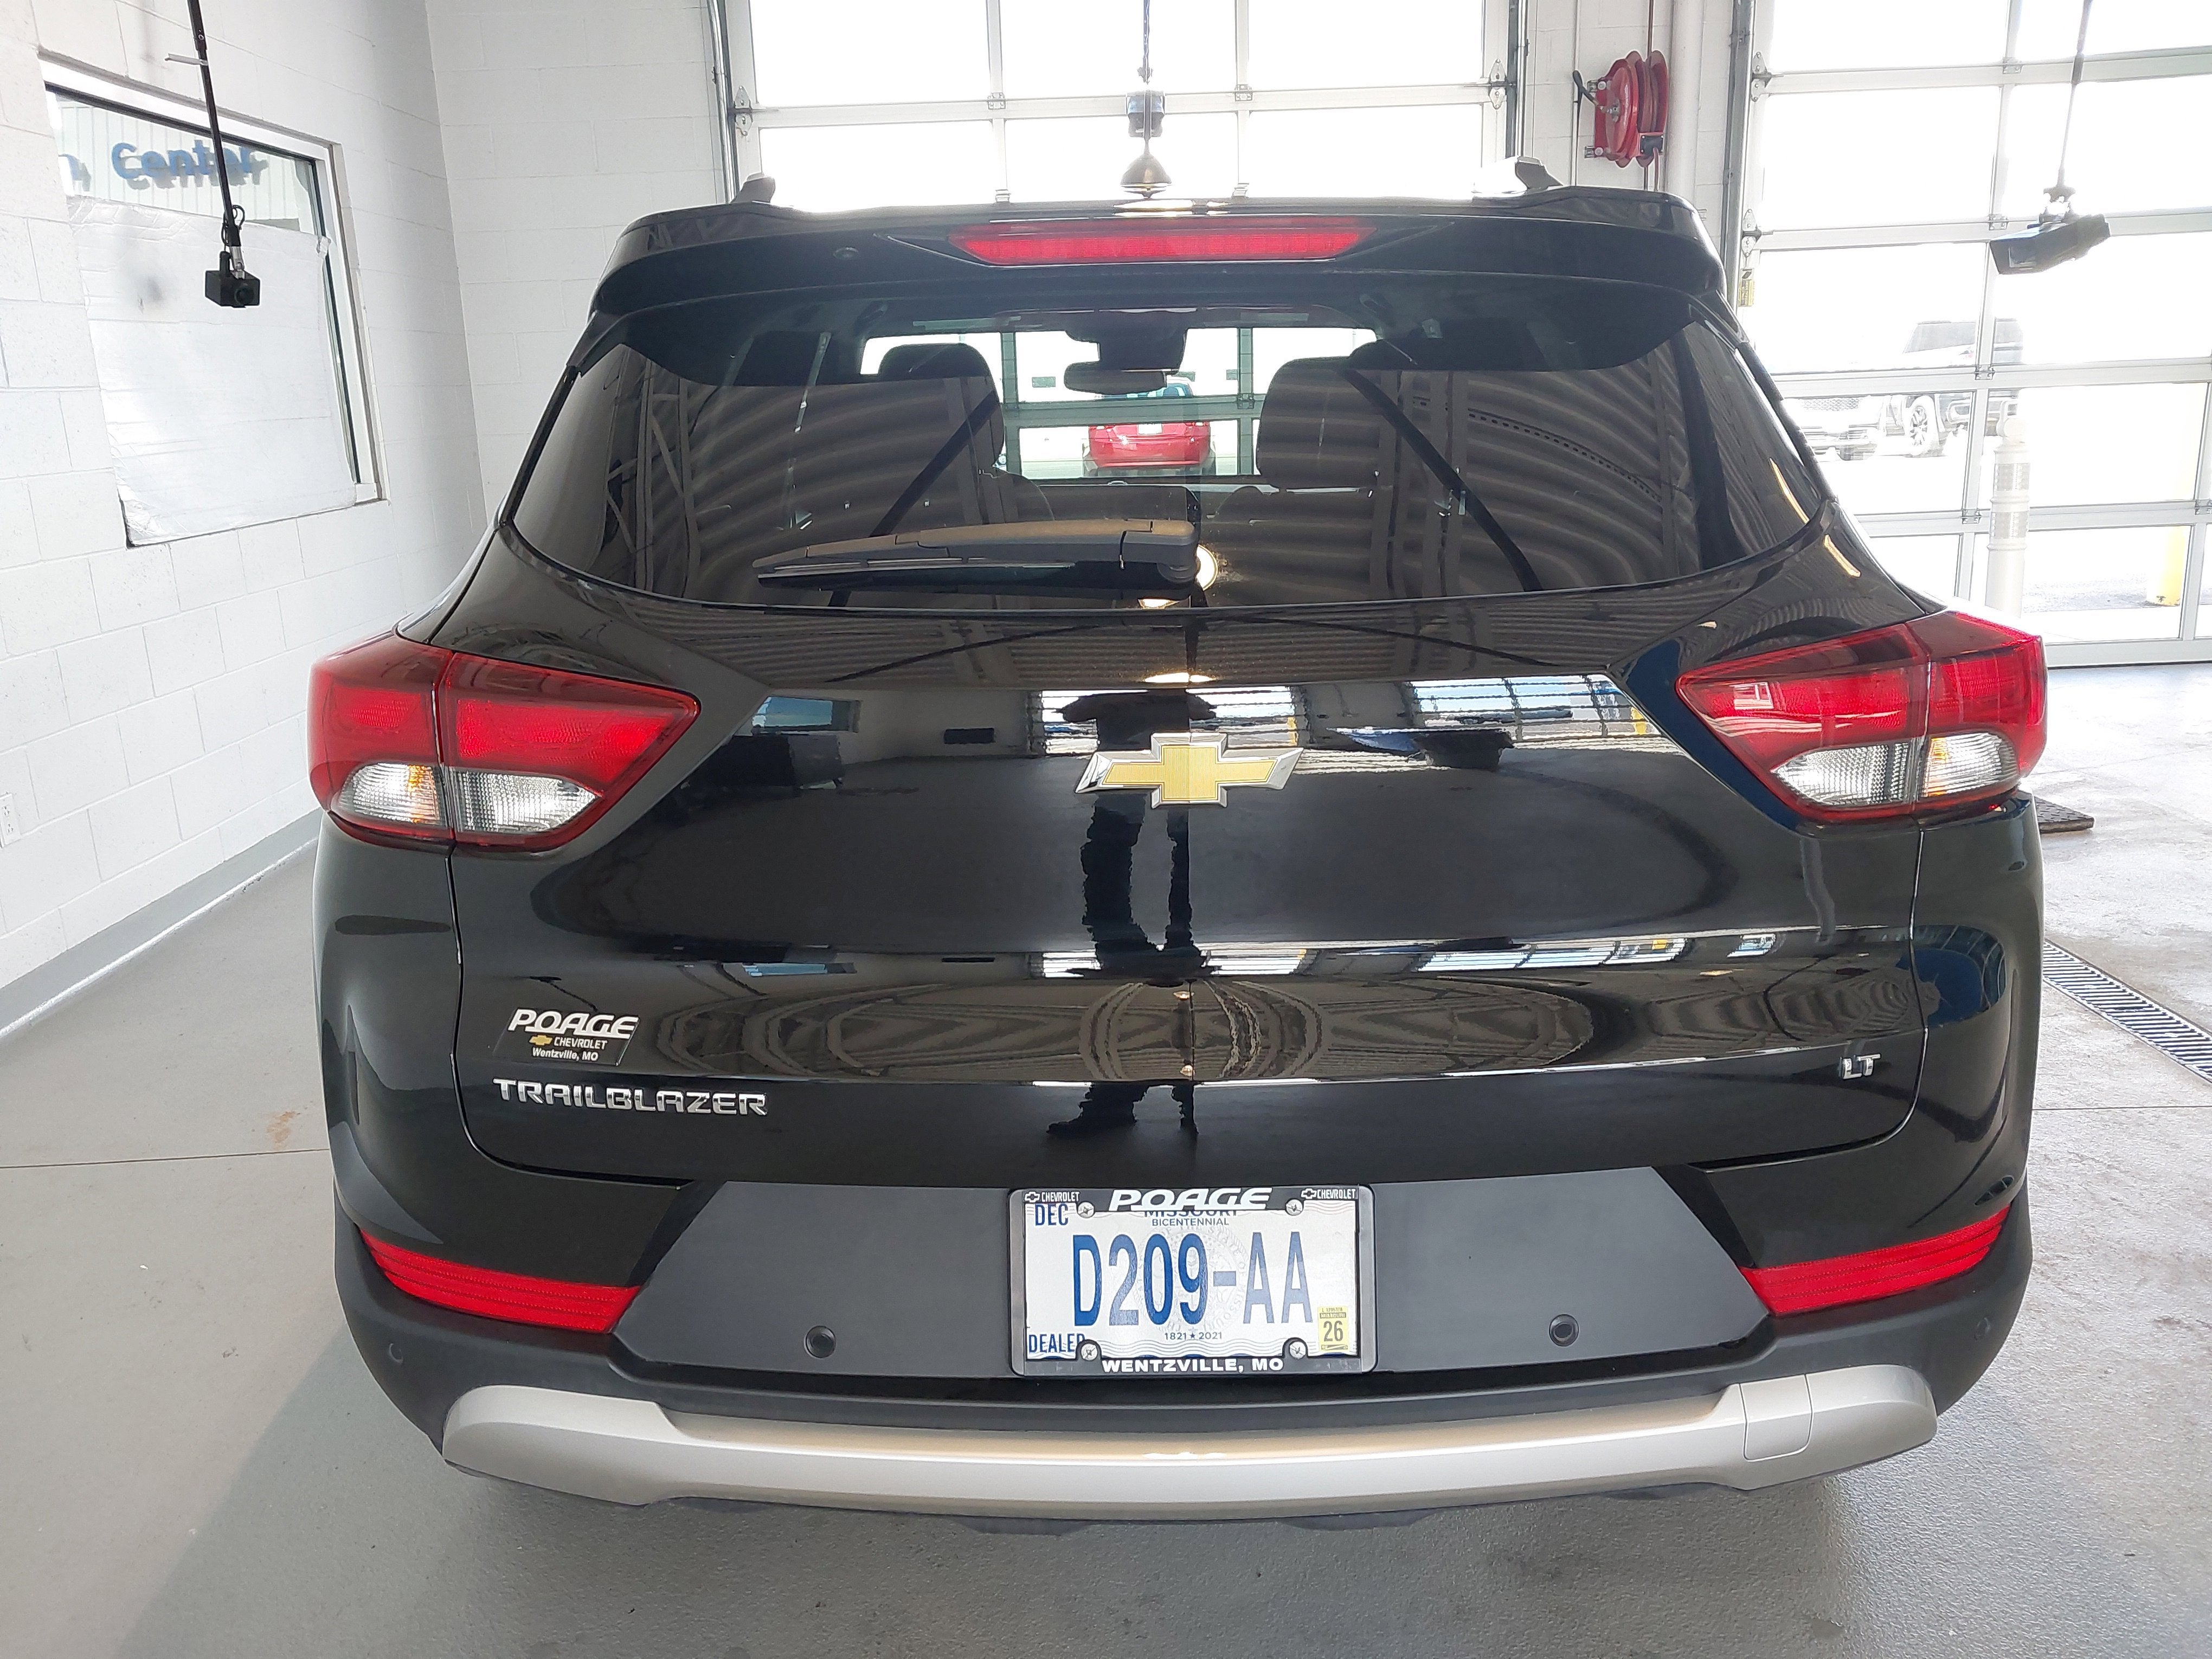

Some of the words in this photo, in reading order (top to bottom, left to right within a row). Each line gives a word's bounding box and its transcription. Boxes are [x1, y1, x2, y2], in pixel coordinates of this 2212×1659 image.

[507, 1008, 640, 1039] POAGE
[554, 1037, 608, 1050] CHEVROLET
[582, 1051, 599, 1061] MO
[1840, 1053, 1881, 1079] LT
[493, 1077, 768, 1116] TRAILBLAZER
[1041, 1191, 1080, 1202] CHEVROLET
[1108, 1188, 1273, 1211] POAGE
[1317, 1188, 1356, 1199] CHEVROLET
[1034, 1203, 1069, 1226] DEC
[1152, 1218, 1230, 1226] BICENTENNIAL
[1072, 1231, 1312, 1326] D209-AA
[1164, 1332, 1187, 1340] 1821
[1199, 1332, 1222, 1340] 2021
[1323, 1320, 1343, 1342] 26
[1252, 1358, 1283, 1371] MO
